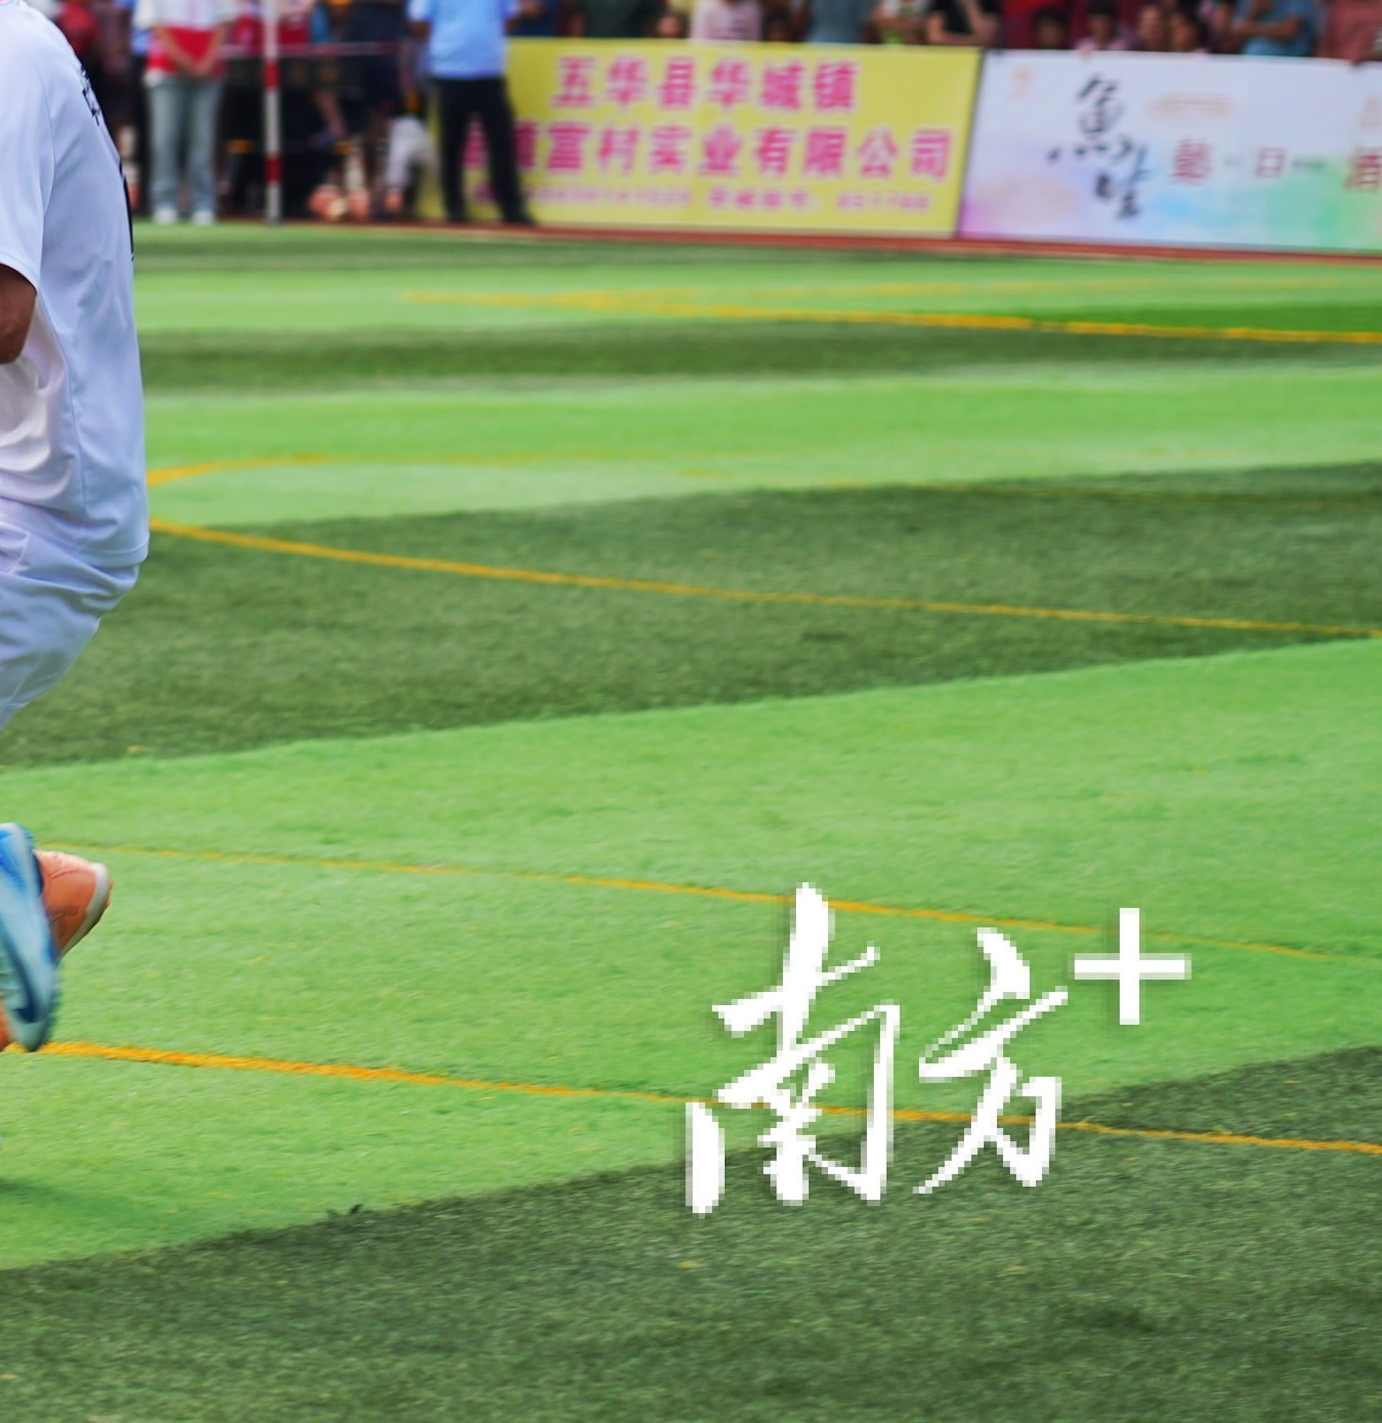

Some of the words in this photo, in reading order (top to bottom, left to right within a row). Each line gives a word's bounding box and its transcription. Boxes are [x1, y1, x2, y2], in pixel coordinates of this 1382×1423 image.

[552, 54, 860, 114] 五华县华城镇
